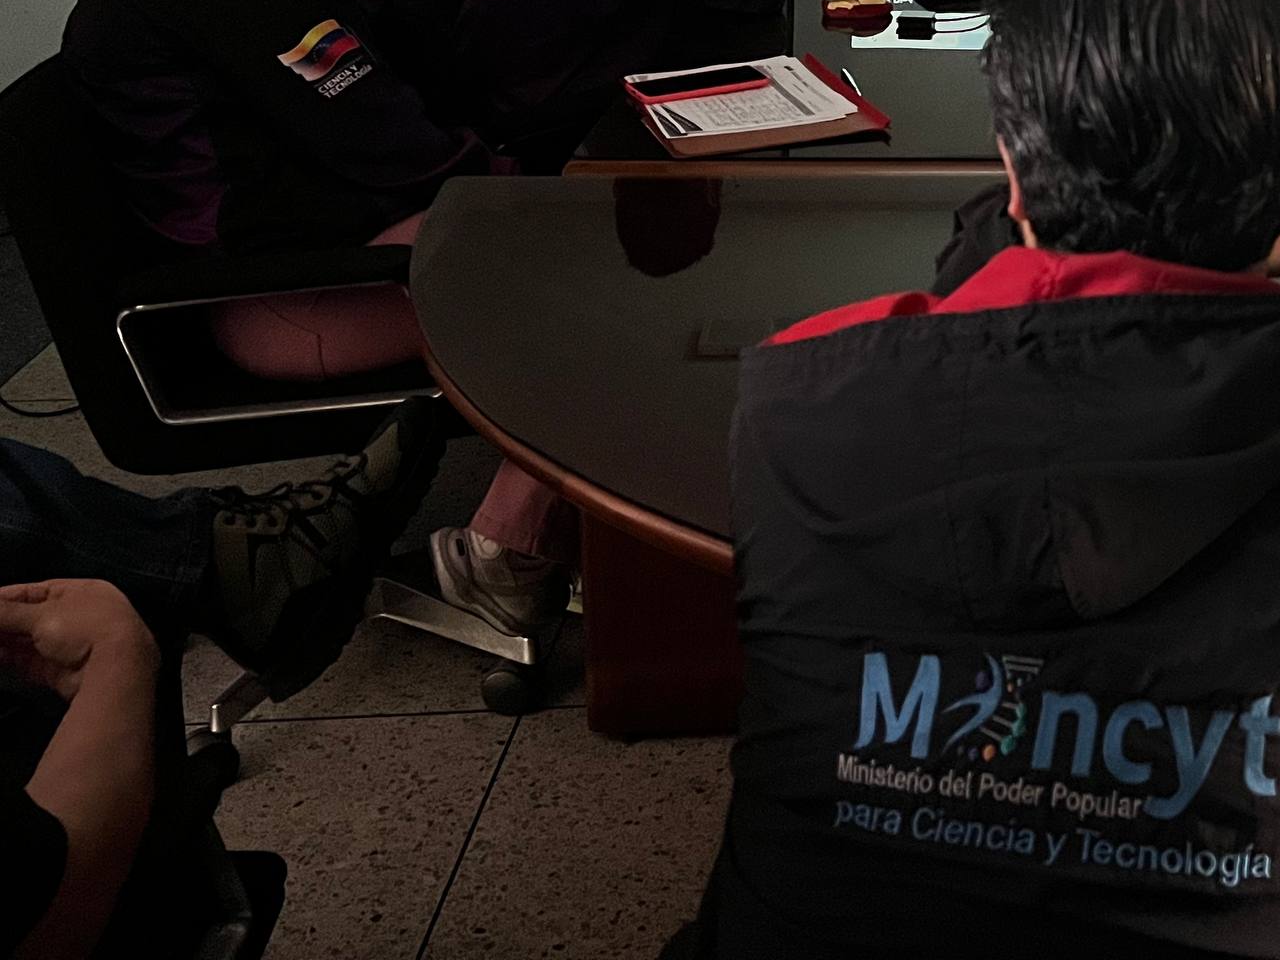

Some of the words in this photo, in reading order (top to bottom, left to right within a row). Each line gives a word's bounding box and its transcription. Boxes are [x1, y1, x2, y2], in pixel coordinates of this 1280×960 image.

[317, 68, 353, 94] CIENCIA
[350, 64, 359, 72] Y
[837, 752, 933, 796] Ministerio
[939, 766, 973, 800] del
[978, 771, 1045, 808] Poder
[1051, 780, 1145, 821] Popular
[833, 798, 902, 835] para
[911, 805, 1036, 855] Ciencia
[1044, 830, 1068, 867] y
[1074, 825, 1273, 888] Tecnología
